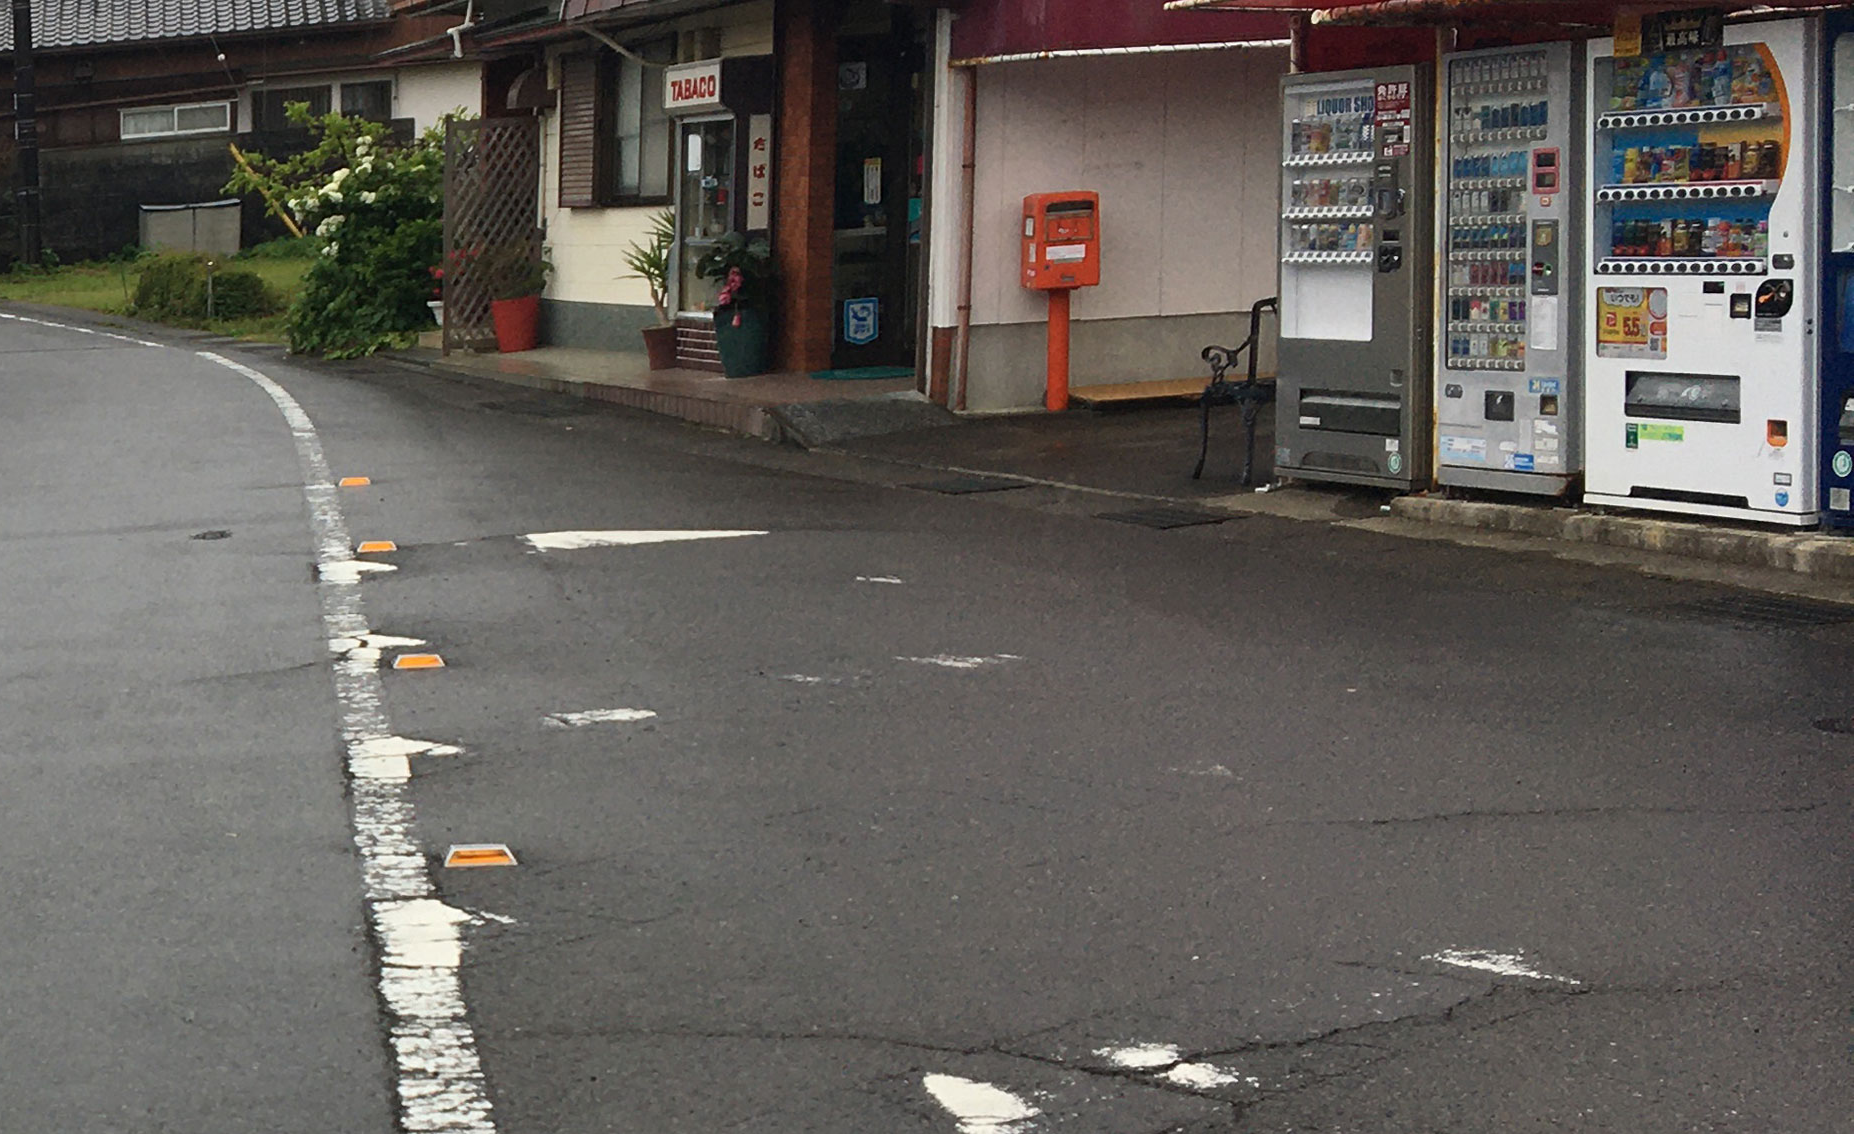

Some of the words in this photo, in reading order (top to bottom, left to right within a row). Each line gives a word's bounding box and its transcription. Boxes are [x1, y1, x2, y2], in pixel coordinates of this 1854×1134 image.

[671, 75, 716, 101] TABACO
[1317, 98, 1352, 116] LIQUOR
[752, 137, 767, 207] たばこ
